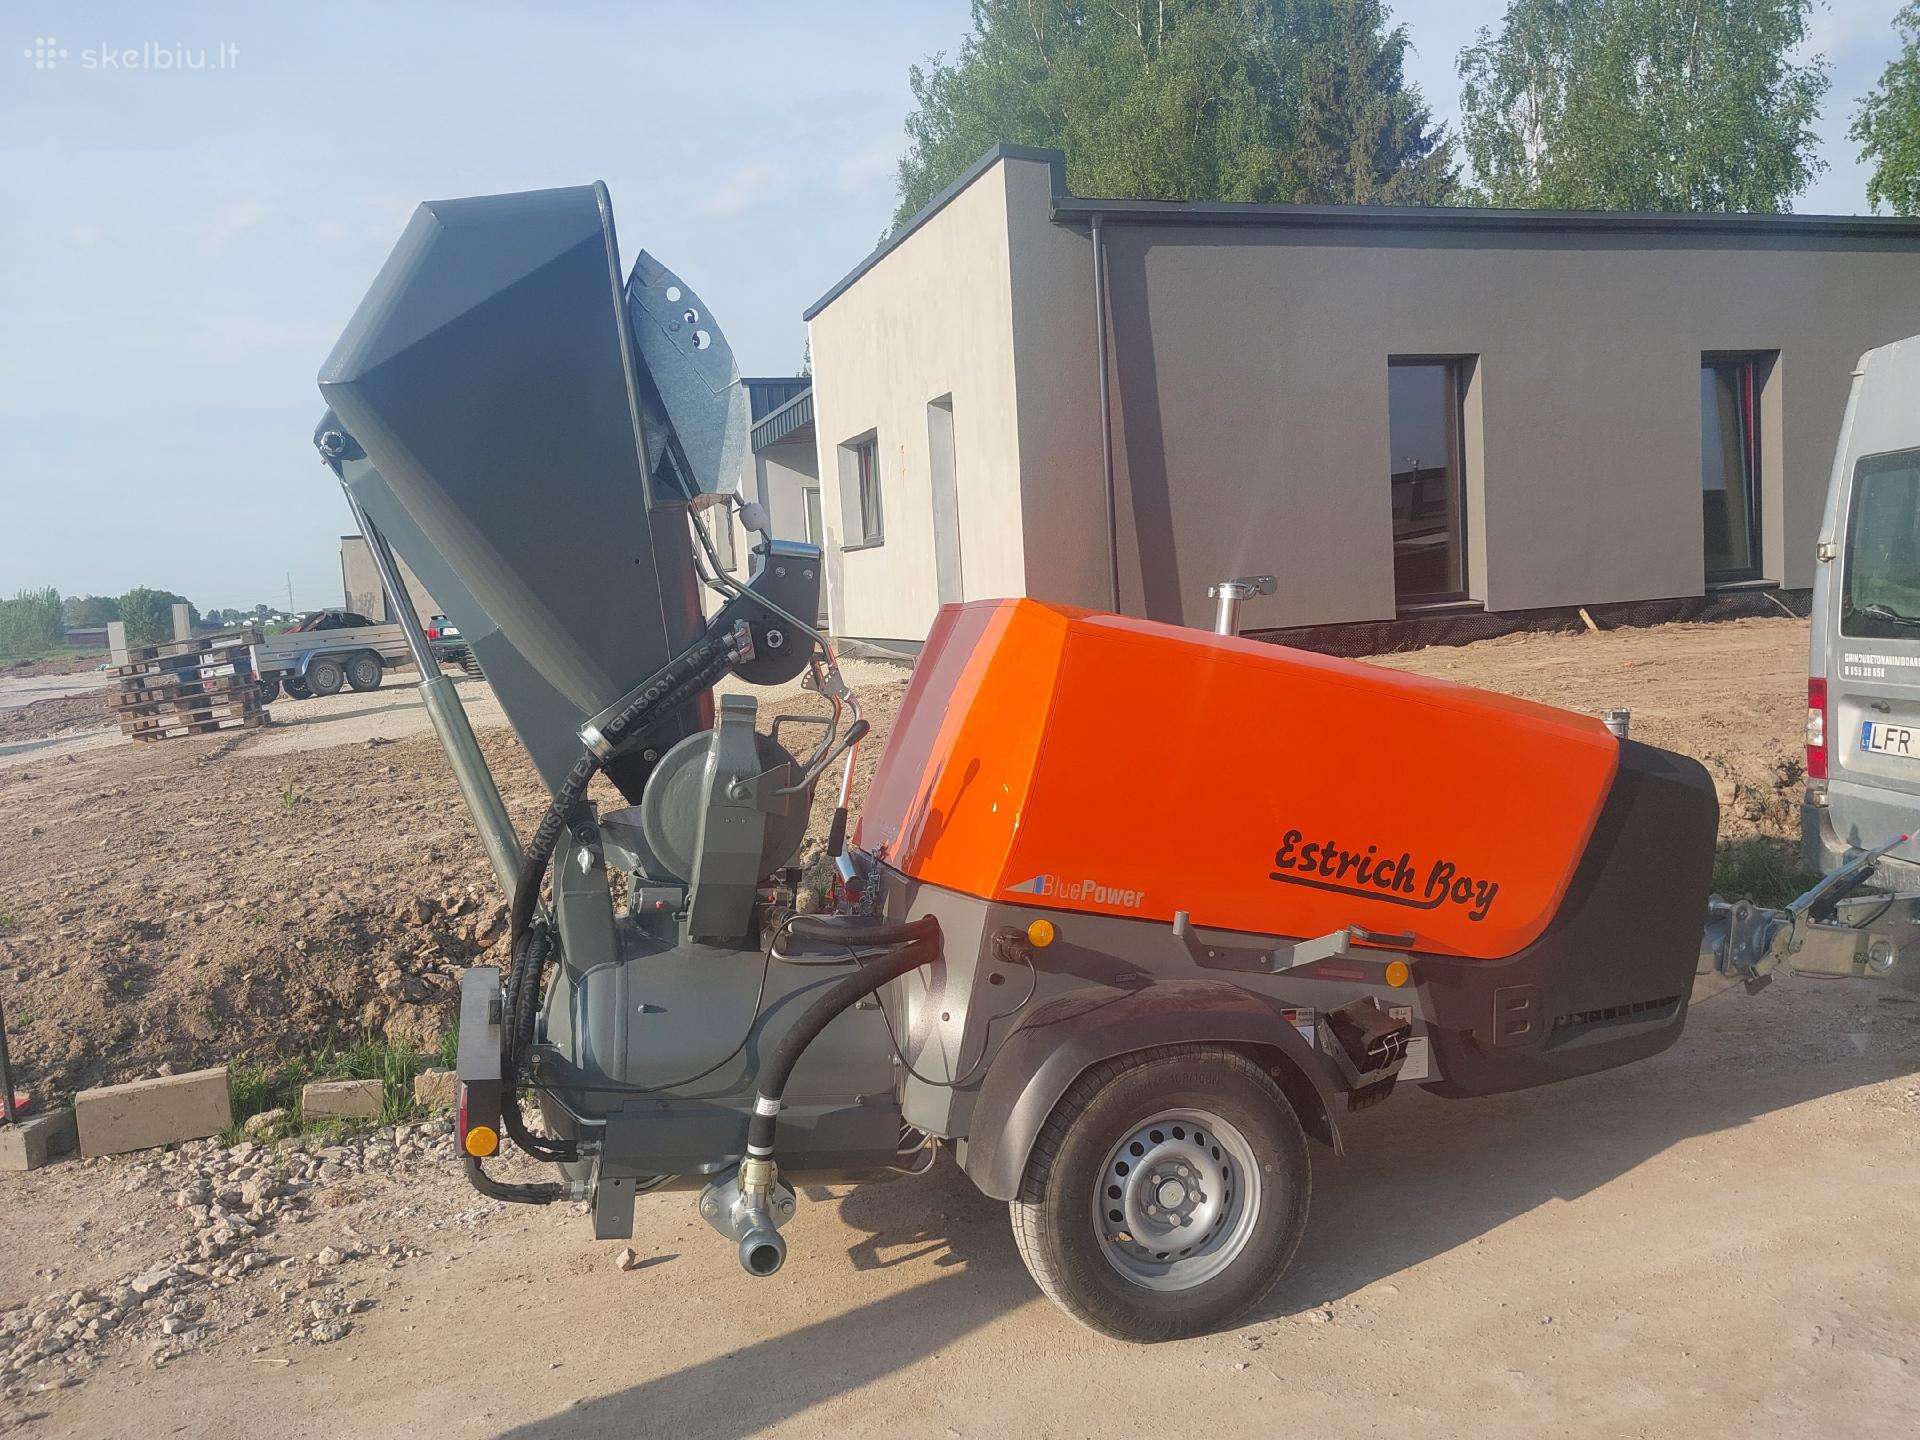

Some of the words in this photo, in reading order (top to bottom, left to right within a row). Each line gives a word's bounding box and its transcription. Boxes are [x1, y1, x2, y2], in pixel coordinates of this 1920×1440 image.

[1871, 725, 1911, 754] LFR
[1041, 873, 1146, 909] BluePower
[1274, 829, 1416, 894] Estrich
[1424, 860, 1499, 922] Boy
